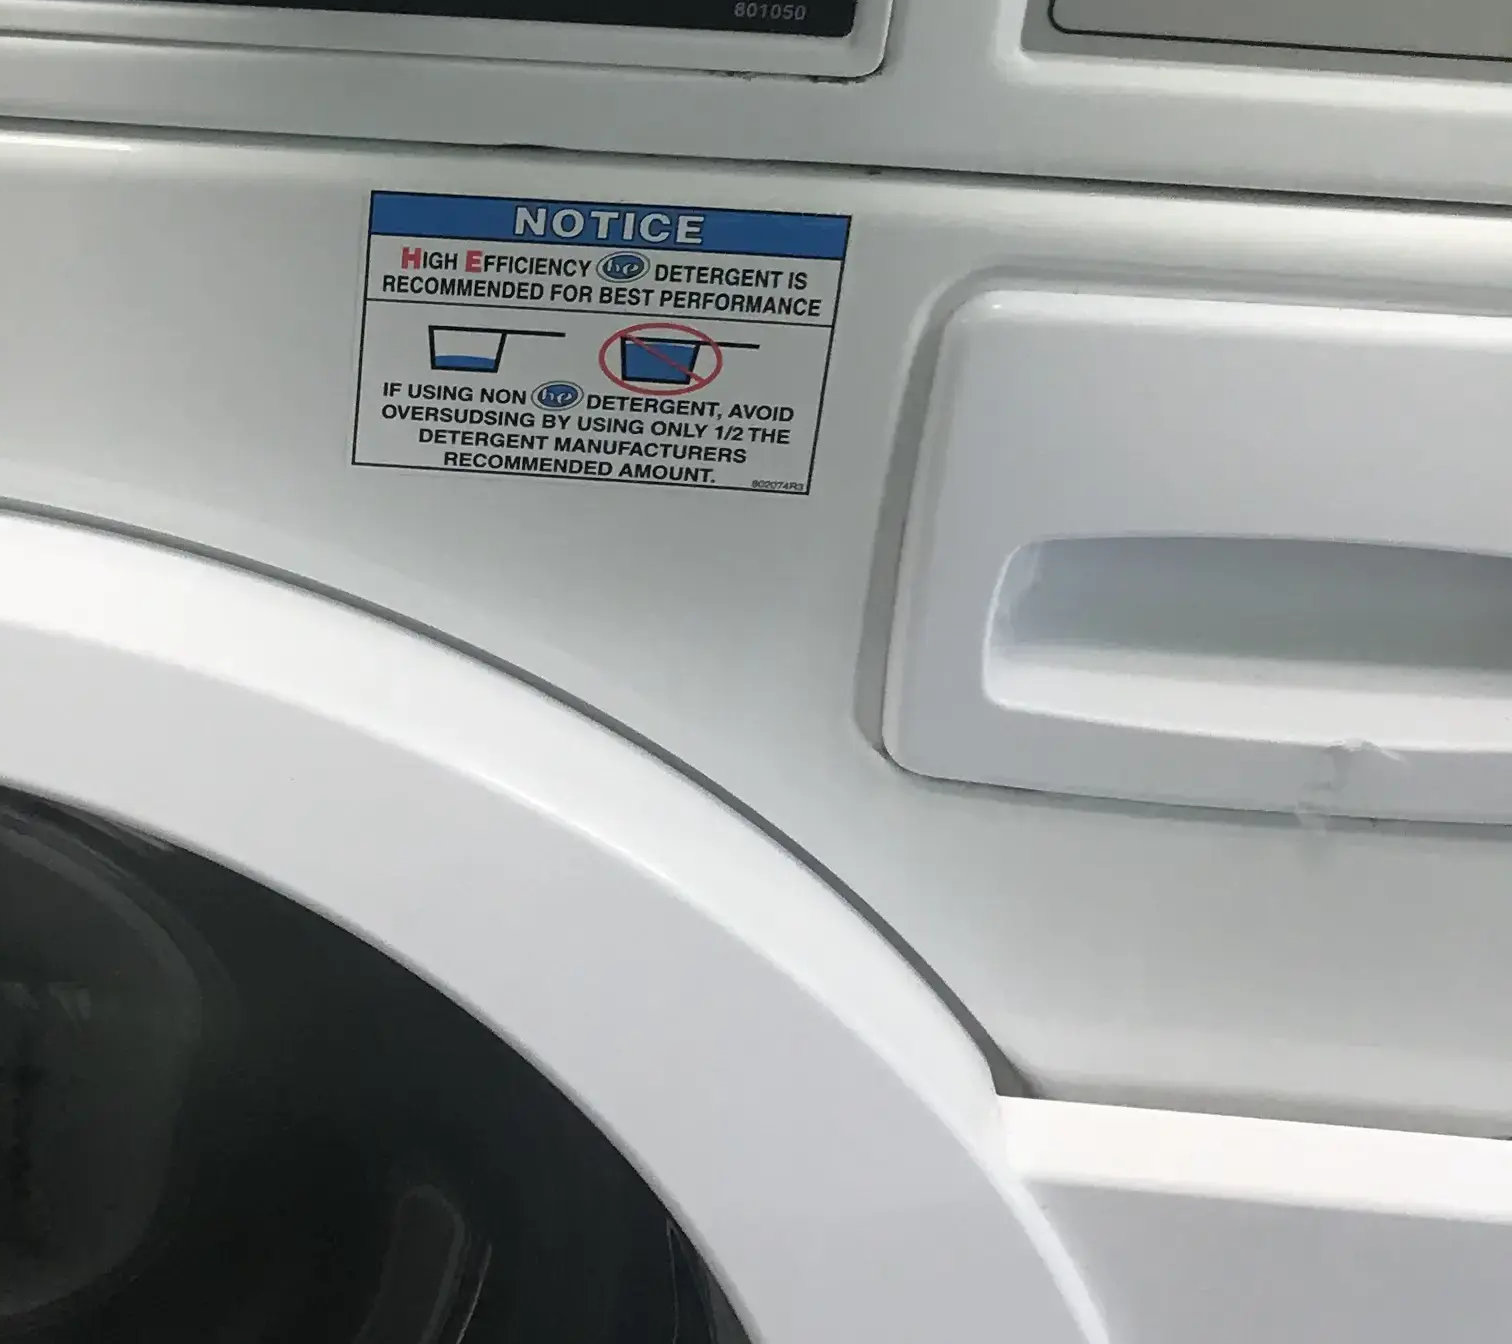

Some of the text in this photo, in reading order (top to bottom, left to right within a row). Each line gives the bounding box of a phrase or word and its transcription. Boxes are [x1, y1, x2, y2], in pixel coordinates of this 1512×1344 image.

[733, 2, 807, 21] 801050
[513, 206, 705, 246] NOTICE
[401, 247, 458, 271] HIGH
[465, 250, 592, 277] EFFICIENCY
[654, 264, 783, 289] DETERGENT
[788, 272, 808, 290] IS
[382, 275, 822, 317] RECOMMENDED FOR BEST PERFORMANCE
[383, 382, 402, 397] IF
[408, 384, 473, 402] USING
[480, 388, 527, 405] NON
[586, 394, 723, 420] DETERGENT,
[728, 404, 795, 422] AVOID
[381, 404, 791, 444] OVERSUDSING BY USING ONLY 1/2 THE
[418, 428, 748, 464] DETERGENT MANUFACTURERS
[443, 451, 716, 484] RECOMMENDED AMOUNT.
